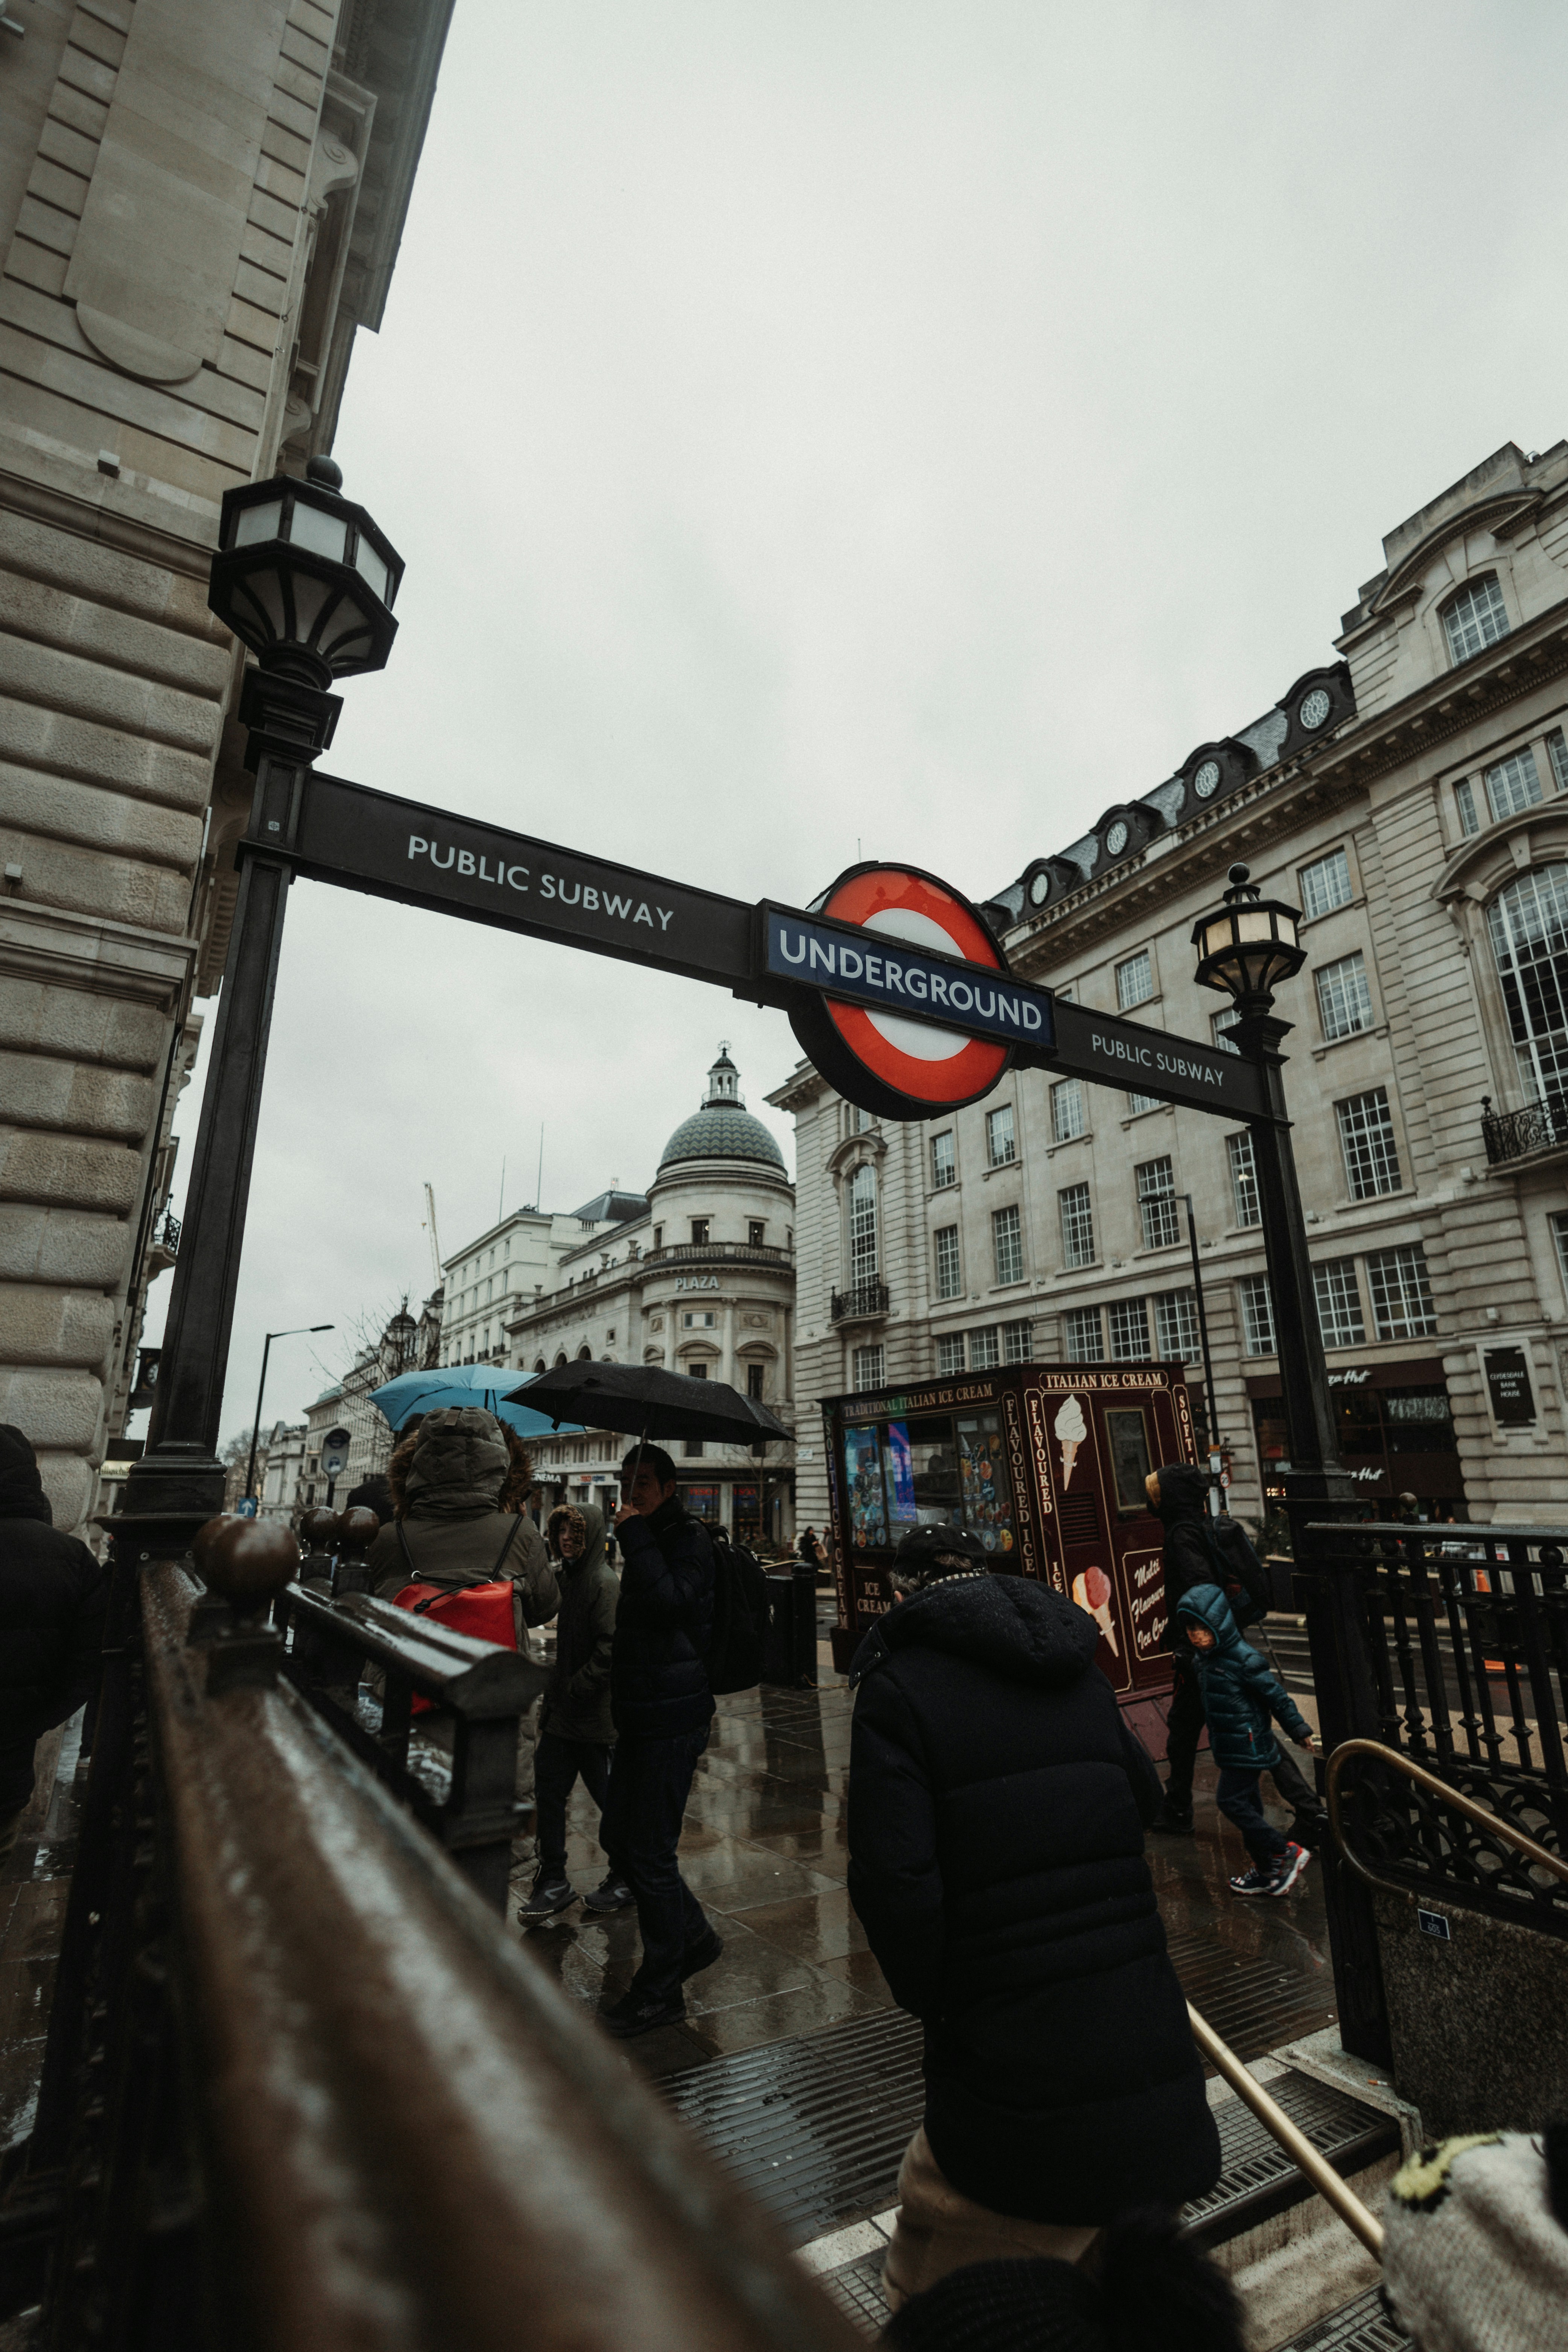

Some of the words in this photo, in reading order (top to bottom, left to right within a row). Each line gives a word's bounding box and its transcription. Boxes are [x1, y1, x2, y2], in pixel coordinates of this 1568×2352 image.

[408, 835, 529, 891] PUBLIC
[540, 874, 674, 931] SUBWAY
[780, 930, 1042, 1030] UNDERGROUND
[1092, 1034, 1152, 1066] PUBLIC
[1156, 1053, 1223, 1086] SUBWAY
[675, 1275, 719, 1292] PLAZA
[1046, 1374, 1097, 1388] ITALIAN
[1100, 1374, 1119, 1387] ICE
[1122, 1373, 1162, 1387] CREAM
[1343, 1369, 1372, 1384] Hut
[1490, 1371, 1524, 1380] CLYDESDALE
[844, 1398, 896, 1417] TRADITIONAL
[899, 1392, 937, 1409] ITALIAN
[938, 1390, 954, 1403] ICE
[956, 1383, 993, 1401] CREAM
[1500, 1389, 1520, 1398] HOUSE
[1179, 1395, 1192, 1451] SOFT
[826, 1421, 835, 1484] SOFT
[1006, 1400, 1030, 1523] FLAVOURED
[1023, 1529, 1035, 1572] ICE
[1031, 1400, 1052, 1514] FLAVOURED
[1053, 1561, 1063, 1593] ICE
[831, 1491, 840, 1540] ICE
[835, 1547, 849, 1629] CREAM
[864, 1582, 880, 1596] ICE
[1134, 1558, 1160, 1588] Multi
[857, 1599, 892, 1614] CREAM
[1138, 1630, 1152, 1650] Ice
